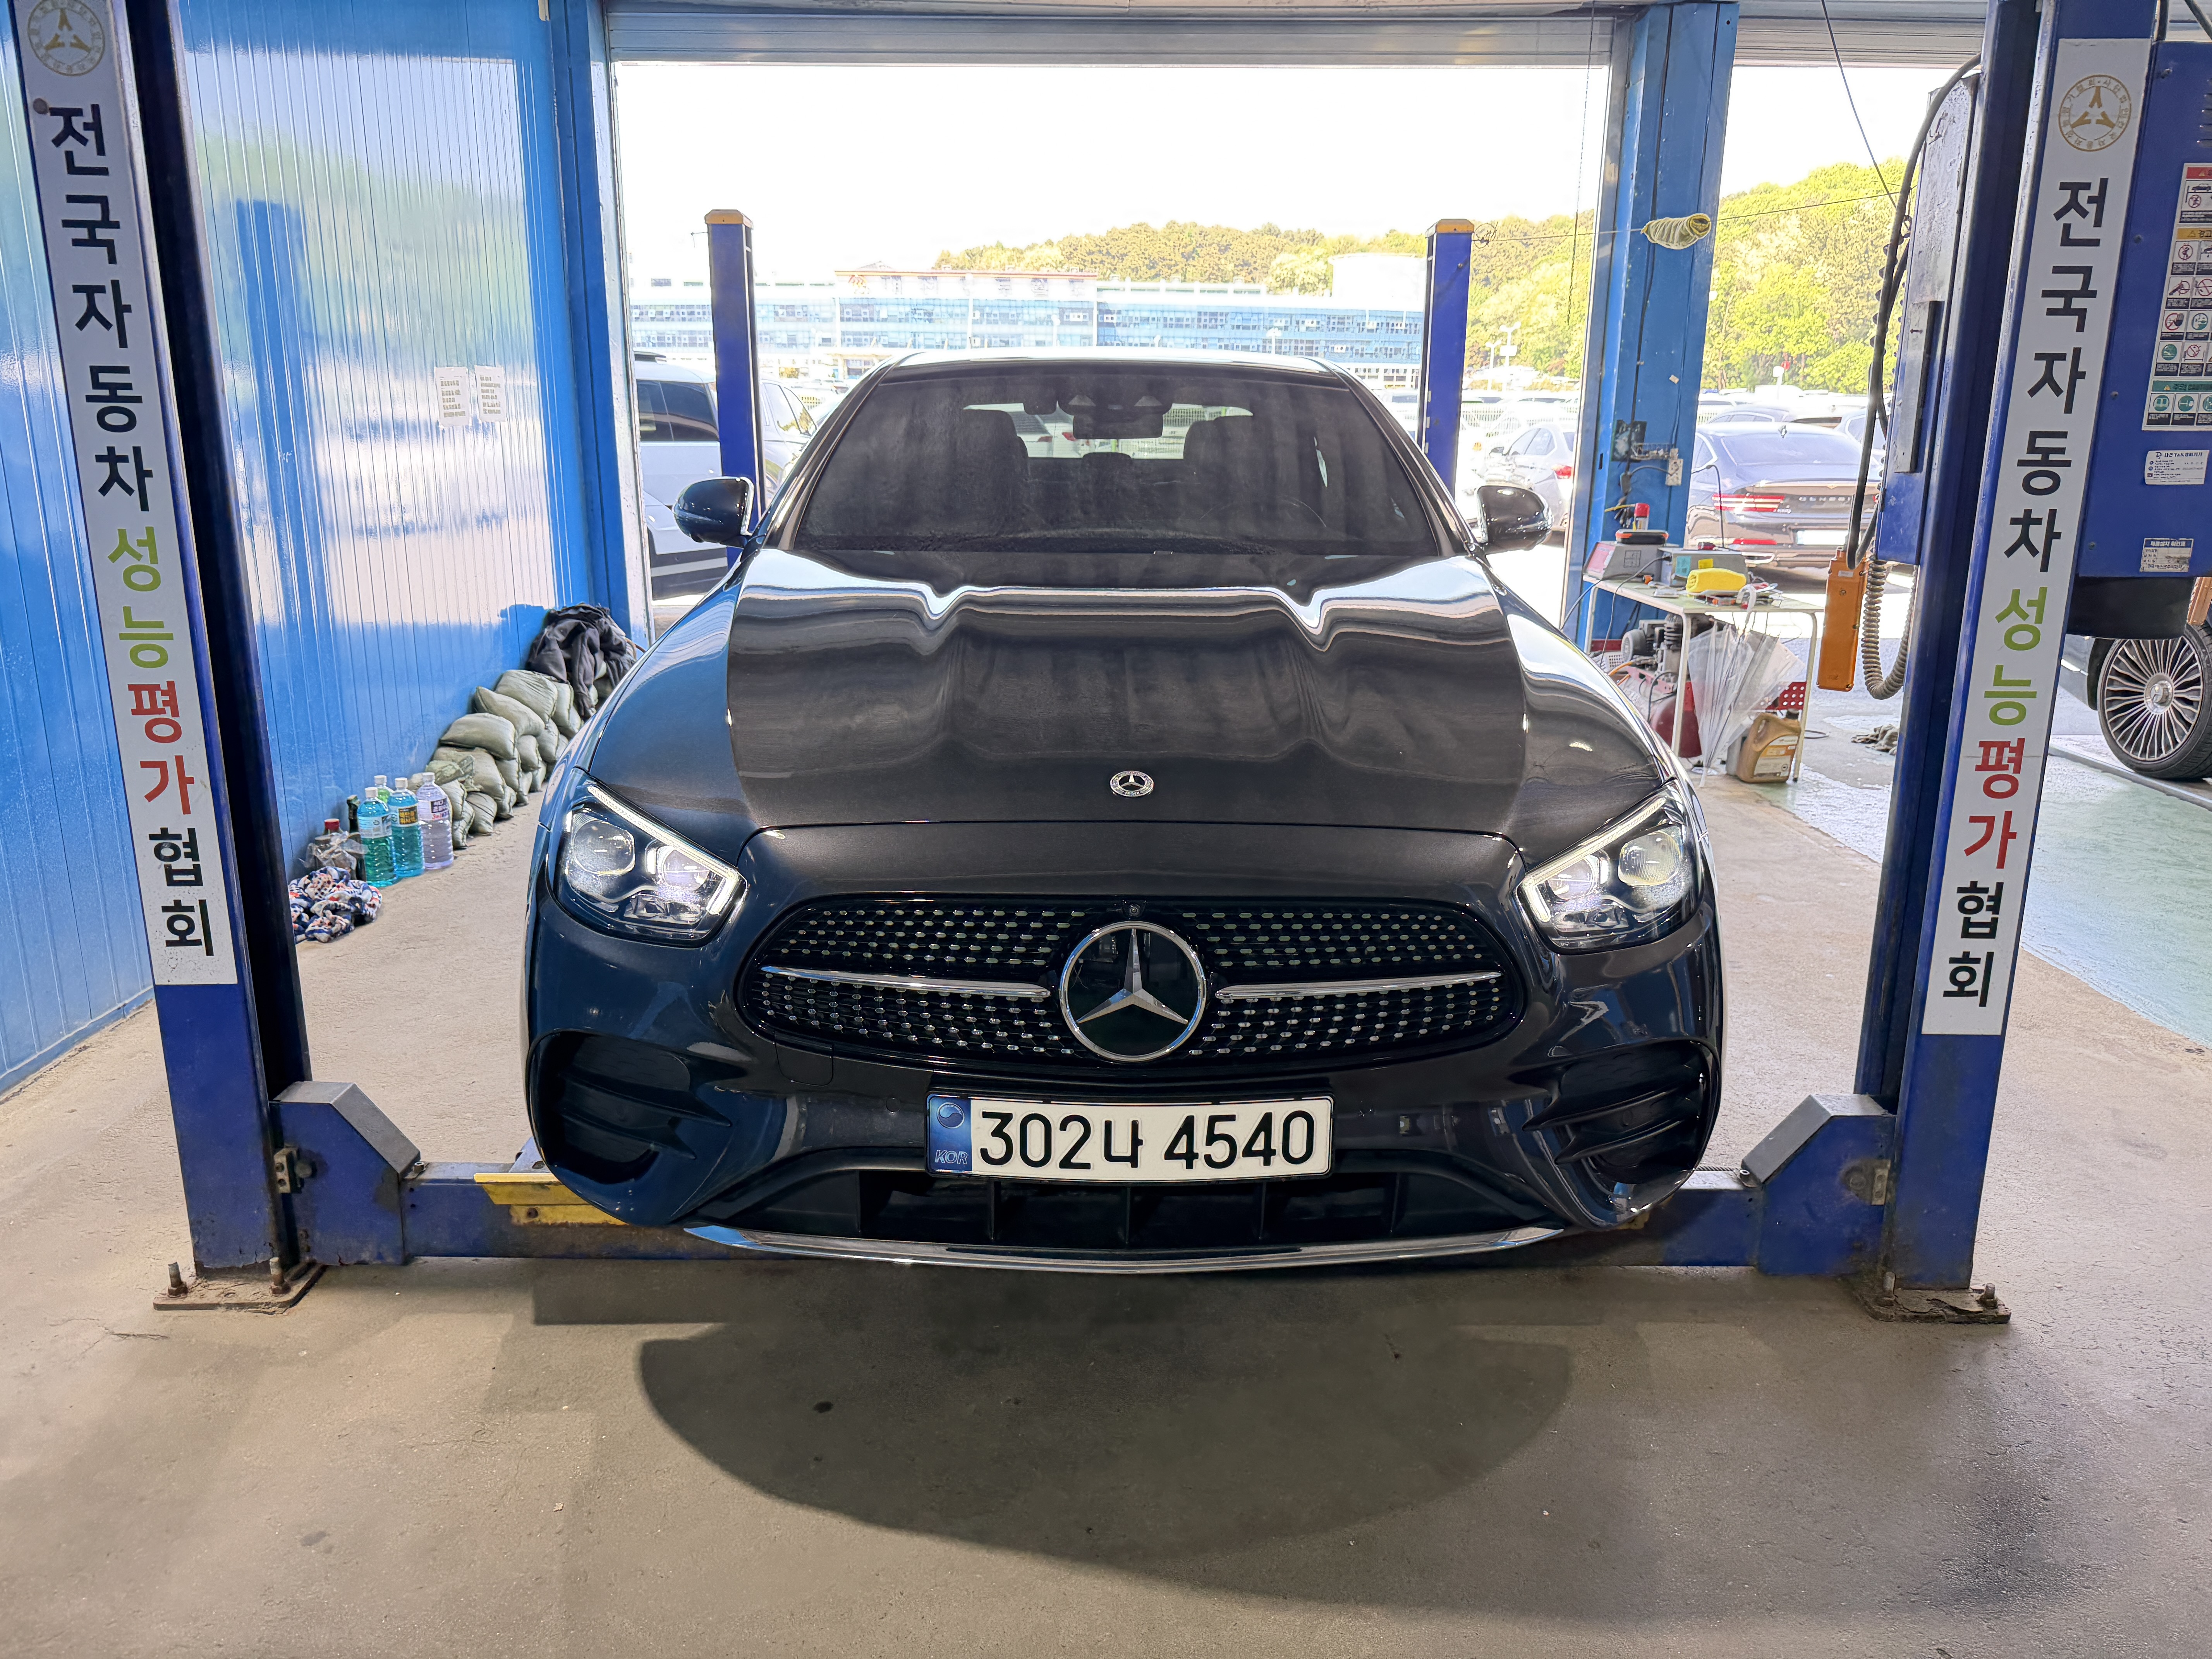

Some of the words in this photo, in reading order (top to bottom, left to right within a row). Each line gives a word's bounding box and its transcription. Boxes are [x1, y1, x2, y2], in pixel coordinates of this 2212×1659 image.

[49, 103, 214, 957] 전국자동차성능평가협회
[1942, 177, 2109, 1007] 전국자동차성능평가협회
[934, 1150, 968, 1164] KOR
[980, 1111, 1144, 1170] 302나
[1164, 1110, 1315, 1170] 4540
